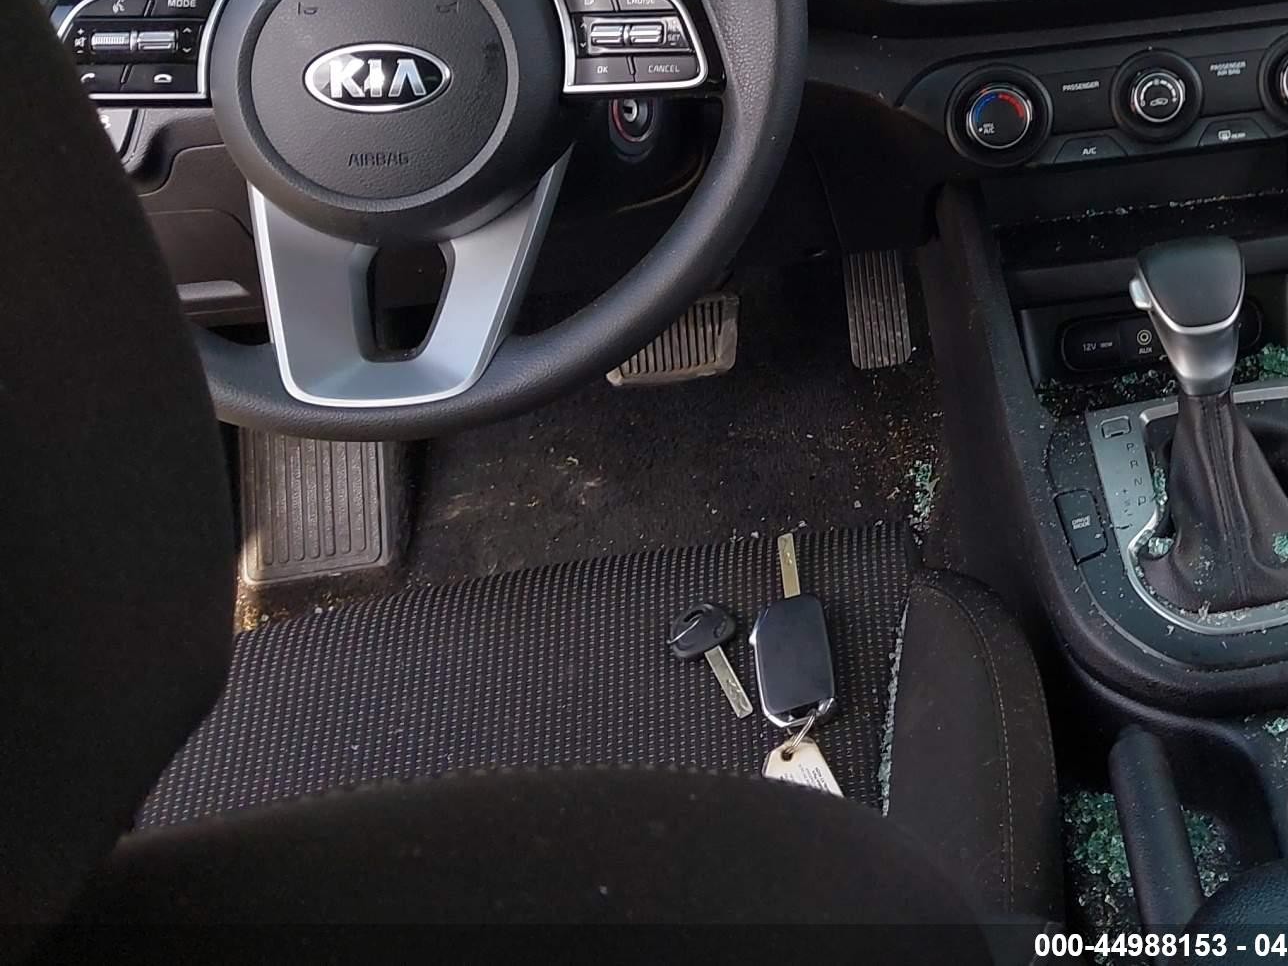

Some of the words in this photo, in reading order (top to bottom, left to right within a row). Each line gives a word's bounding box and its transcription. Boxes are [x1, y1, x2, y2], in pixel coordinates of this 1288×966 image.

[597, 65, 609, 74] OK
[648, 64, 680, 73] CANCEL
[1210, 61, 1247, 71] PASSENGER
[328, 58, 427, 98] KIA
[1062, 80, 1100, 92] PASSENGER
[1082, 146, 1097, 155] A/C
[348, 152, 409, 167] AIRBAG
[1083, 342, 1097, 352] 12V
[1126, 442, 1134, 451] P
[1134, 477, 1143, 487] N
